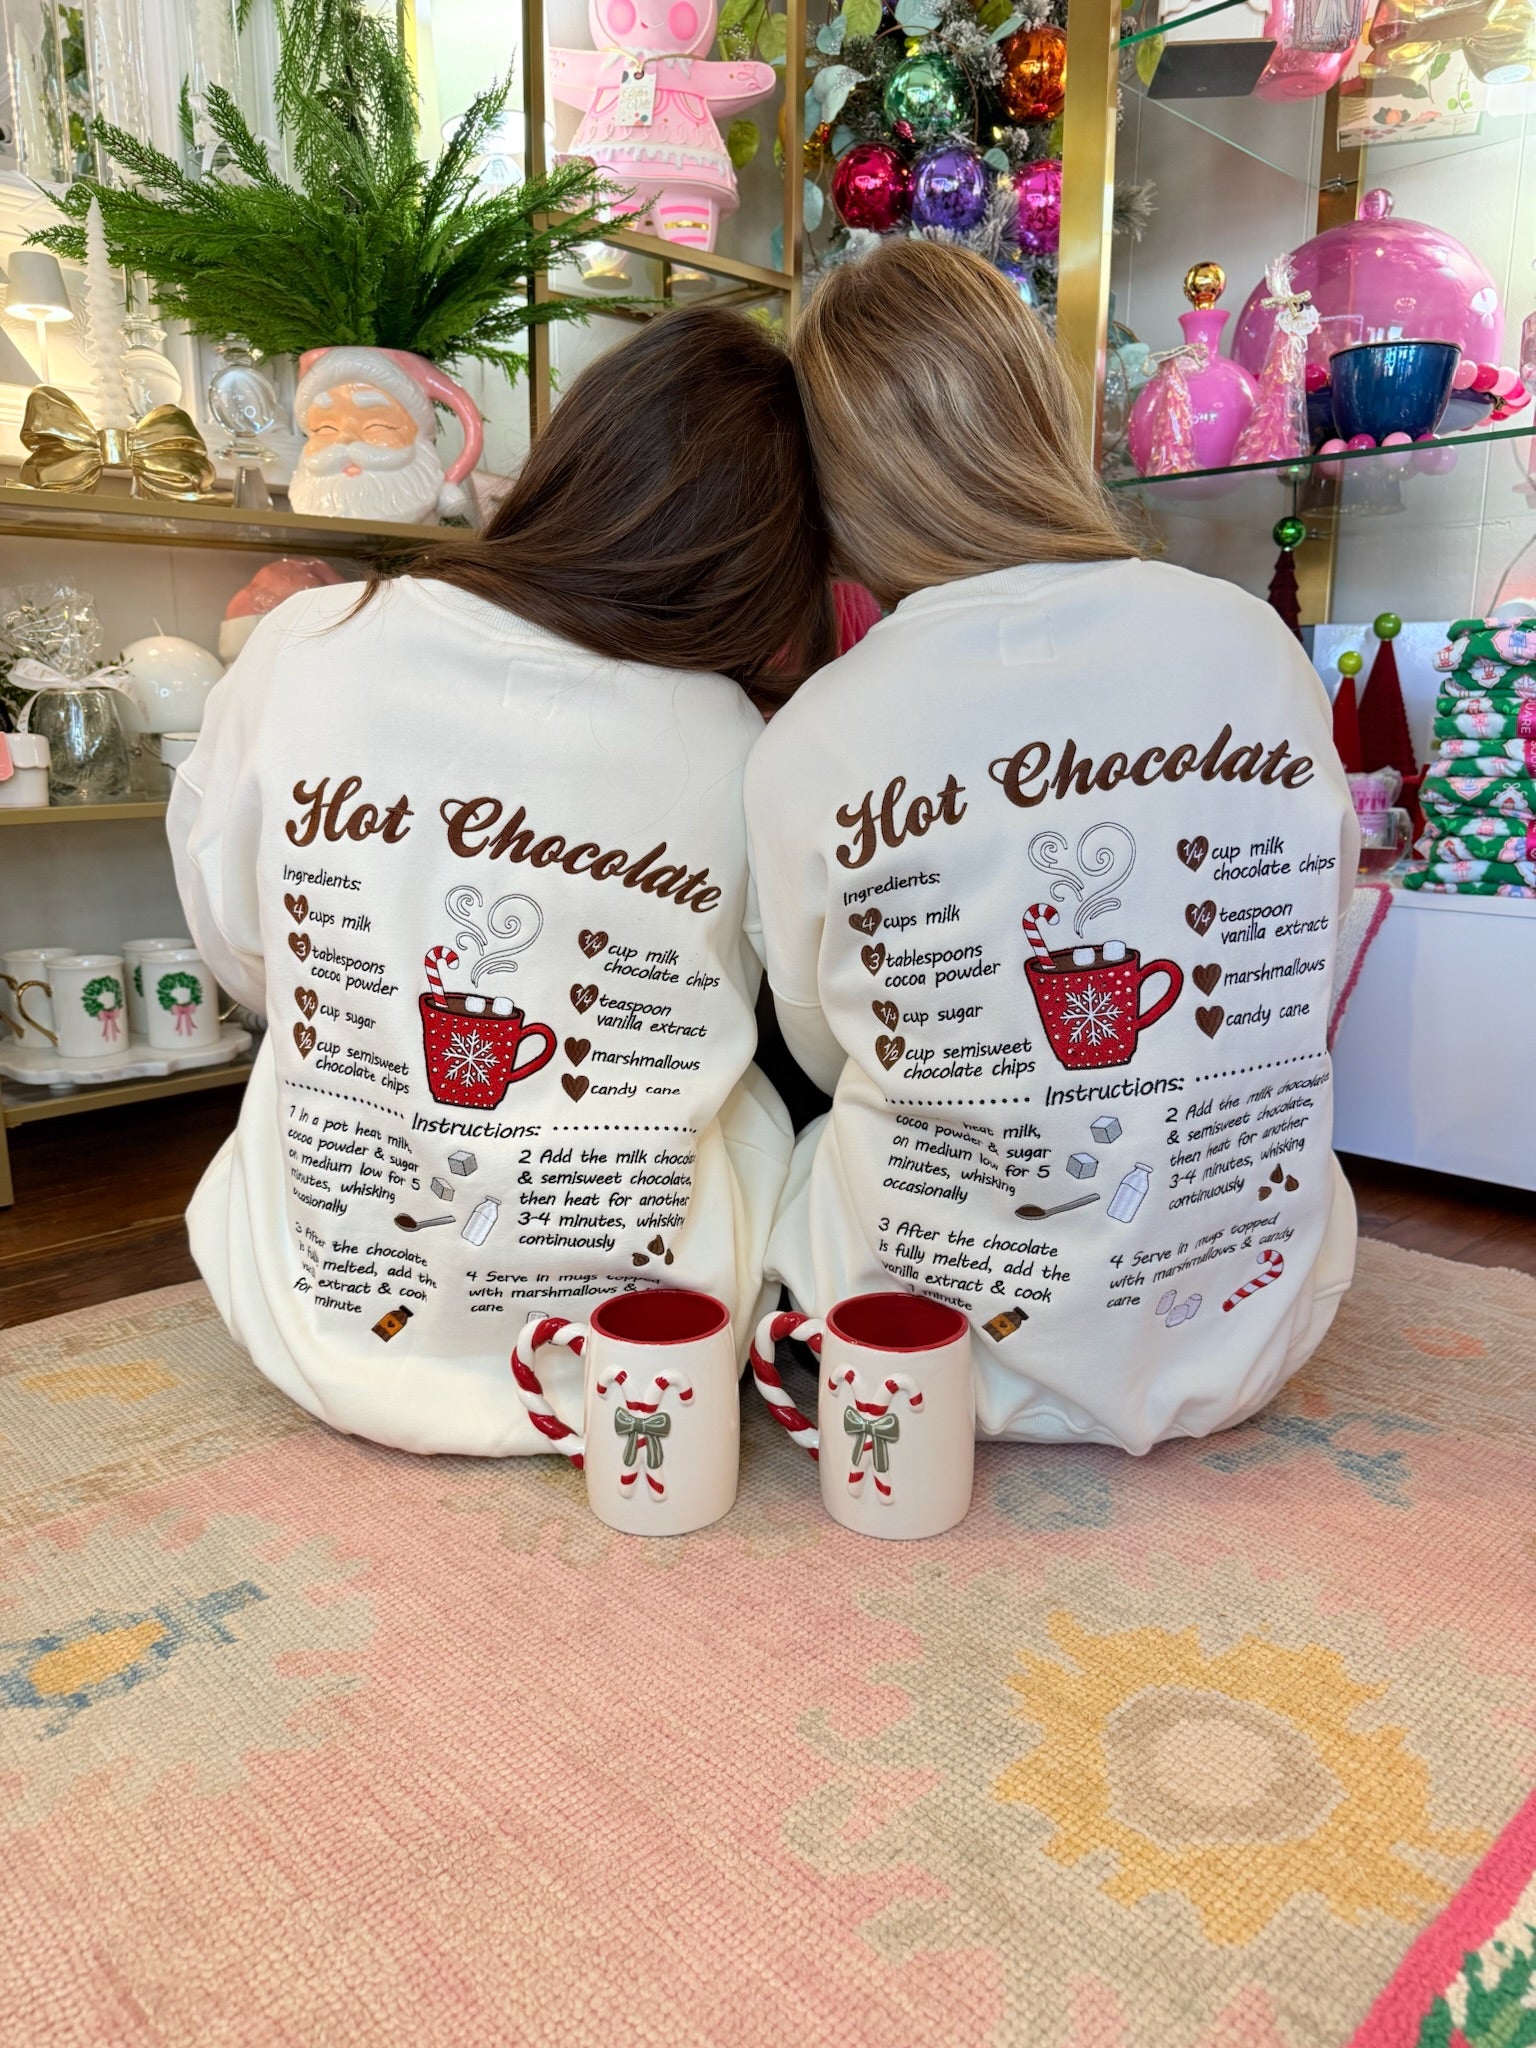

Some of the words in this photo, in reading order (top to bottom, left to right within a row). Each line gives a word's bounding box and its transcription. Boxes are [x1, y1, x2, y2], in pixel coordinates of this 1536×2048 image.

[1521, 699, 1536, 734] UARE
[836, 774, 967, 869] Hot
[988, 723, 1316, 808] Chocolate
[285, 776, 414, 847] Hot
[440, 797, 721, 913] Chocolate
[1211, 846, 1240, 863] cup
[1250, 836, 1284, 857] milk
[283, 865, 362, 891] Ingredients:
[1214, 859, 1291, 881] chocolate
[1300, 853, 1336, 875] chips
[844, 872, 940, 906] Ingredients:
[294, 904, 303, 917] 4
[309, 910, 335, 928] cups
[342, 915, 371, 932] milk
[861, 916, 875, 931] 4
[883, 914, 917, 932] cups
[926, 904, 960, 925] milk
[1220, 903, 1293, 923] teaspoon
[1221, 922, 1266, 944] vanilla
[1275, 916, 1328, 937] extract
[296, 941, 305, 956] 3
[312, 946, 385, 974] tablespoons
[608, 945, 638, 962] cup
[646, 949, 680, 966] milk
[870, 953, 880, 970] 3
[886, 945, 983, 969] tablespoons
[311, 966, 340, 981] cocoa
[346, 976, 398, 996] powder
[604, 959, 679, 983] chocolate
[686, 971, 720, 990] chips
[885, 974, 925, 988] cocoa
[935, 959, 1001, 988] powder
[1224, 957, 1325, 986] marshmallows
[320, 1004, 340, 1021] cup
[346, 1012, 376, 1029] sugar
[599, 994, 672, 1017] teaspoon
[903, 1011, 929, 1027] cup
[937, 1005, 983, 1024] sugar
[1226, 1005, 1271, 1026] candy
[1279, 1003, 1310, 1019] cane
[597, 1014, 642, 1032] vanilla
[650, 1020, 707, 1037] extract
[317, 1041, 340, 1058] cup
[347, 1048, 409, 1076] semisweet
[591, 1050, 700, 1070] marshmallows
[905, 1048, 935, 1065] cup
[943, 1038, 1032, 1059] semisweet
[316, 1056, 375, 1082] chocolate
[382, 1073, 410, 1095] chips
[904, 1063, 983, 1080] chocolate
[992, 1057, 1035, 1079] chips
[591, 1082, 637, 1098] candy
[646, 1085, 680, 1096] cane
[1046, 1077, 1184, 1107] Instructions:
[1165, 1108, 1178, 1123] 2
[1186, 1099, 1212, 1121] Add
[1219, 1092, 1240, 1111] the
[1276, 1071, 1330, 1096] chocolate
[312, 1117, 318, 1125] a
[322, 1120, 348, 1132] pot
[412, 1112, 542, 1139] Instructions:
[1003, 1123, 1041, 1139] milk,
[1167, 1130, 1180, 1144] &
[1188, 1113, 1250, 1142] semisweet
[1257, 1096, 1314, 1122] chocolate,
[288, 1128, 312, 1145] cocoa
[317, 1139, 369, 1156] powder
[375, 1147, 384, 1161] &
[390, 1156, 419, 1172] sugar
[896, 1114, 928, 1131] cocoa
[934, 1125, 983, 1145] powder
[1006, 1148, 1052, 1162] sugar
[1170, 1150, 1201, 1167] then
[1206, 1140, 1231, 1158] heat
[1238, 1131, 1258, 1148] for
[1262, 1116, 1309, 1140] another
[518, 1150, 532, 1165] 2
[540, 1149, 572, 1164] Add
[581, 1148, 608, 1164] the
[616, 1149, 647, 1165] milk
[893, 1135, 908, 1148] on
[915, 1140, 972, 1161] medium
[1005, 1165, 1029, 1178] for
[1037, 1165, 1050, 1178] 5
[1169, 1171, 1197, 1189] 3-4
[1202, 1154, 1253, 1180] minutes,
[1260, 1136, 1305, 1161] whisking
[301, 1154, 352, 1174] medium
[360, 1162, 382, 1178] low
[388, 1171, 406, 1186] for
[411, 1178, 420, 1191] 5
[517, 1171, 532, 1184] &
[541, 1172, 622, 1185] semisweet
[630, 1172, 692, 1186] chocolate,
[888, 1154, 950, 1179] minutes,
[961, 1168, 1016, 1196] whisking
[341, 1181, 395, 1204] whisking
[520, 1192, 555, 1206] then
[565, 1193, 599, 1206] heat
[609, 1192, 632, 1206] for
[639, 1192, 690, 1206] another
[883, 1177, 968, 1204] occasionally
[1169, 1175, 1246, 1210] continuously
[517, 1212, 551, 1226] 3-4
[559, 1214, 626, 1230] minutes,
[519, 1233, 616, 1251] continuously
[879, 1218, 889, 1231] 3
[896, 1221, 940, 1241] After
[948, 1230, 975, 1247] the
[983, 1234, 1058, 1257] chocolate
[1110, 1254, 1123, 1269] 4
[1131, 1250, 1172, 1267] Serve
[1231, 1212, 1280, 1235] topped
[333, 1240, 358, 1255] the
[366, 1243, 427, 1267] chocolate
[879, 1239, 888, 1252] is
[895, 1243, 925, 1264] fully
[932, 1252, 993, 1274] melted,
[1004, 1260, 1034, 1277] add
[1042, 1265, 1071, 1282] the
[1110, 1272, 1144, 1289] with
[1240, 1236, 1252, 1248] &
[1259, 1227, 1295, 1242] candy
[323, 1260, 377, 1276] melted,
[388, 1266, 411, 1279] add
[466, 1271, 478, 1280] 4
[486, 1272, 528, 1283] Serve
[881, 1260, 919, 1280] vanilla
[925, 1274, 983, 1293] extract
[991, 1280, 1005, 1295] &
[1015, 1287, 1053, 1303] cook
[294, 1277, 313, 1294] for
[315, 1295, 362, 1313] minute
[318, 1279, 371, 1295] extract
[378, 1283, 391, 1295] &
[470, 1287, 503, 1297] with
[511, 1285, 617, 1298] marshmallows
[471, 1303, 504, 1312] cane
[1107, 1295, 1140, 1309] cane
